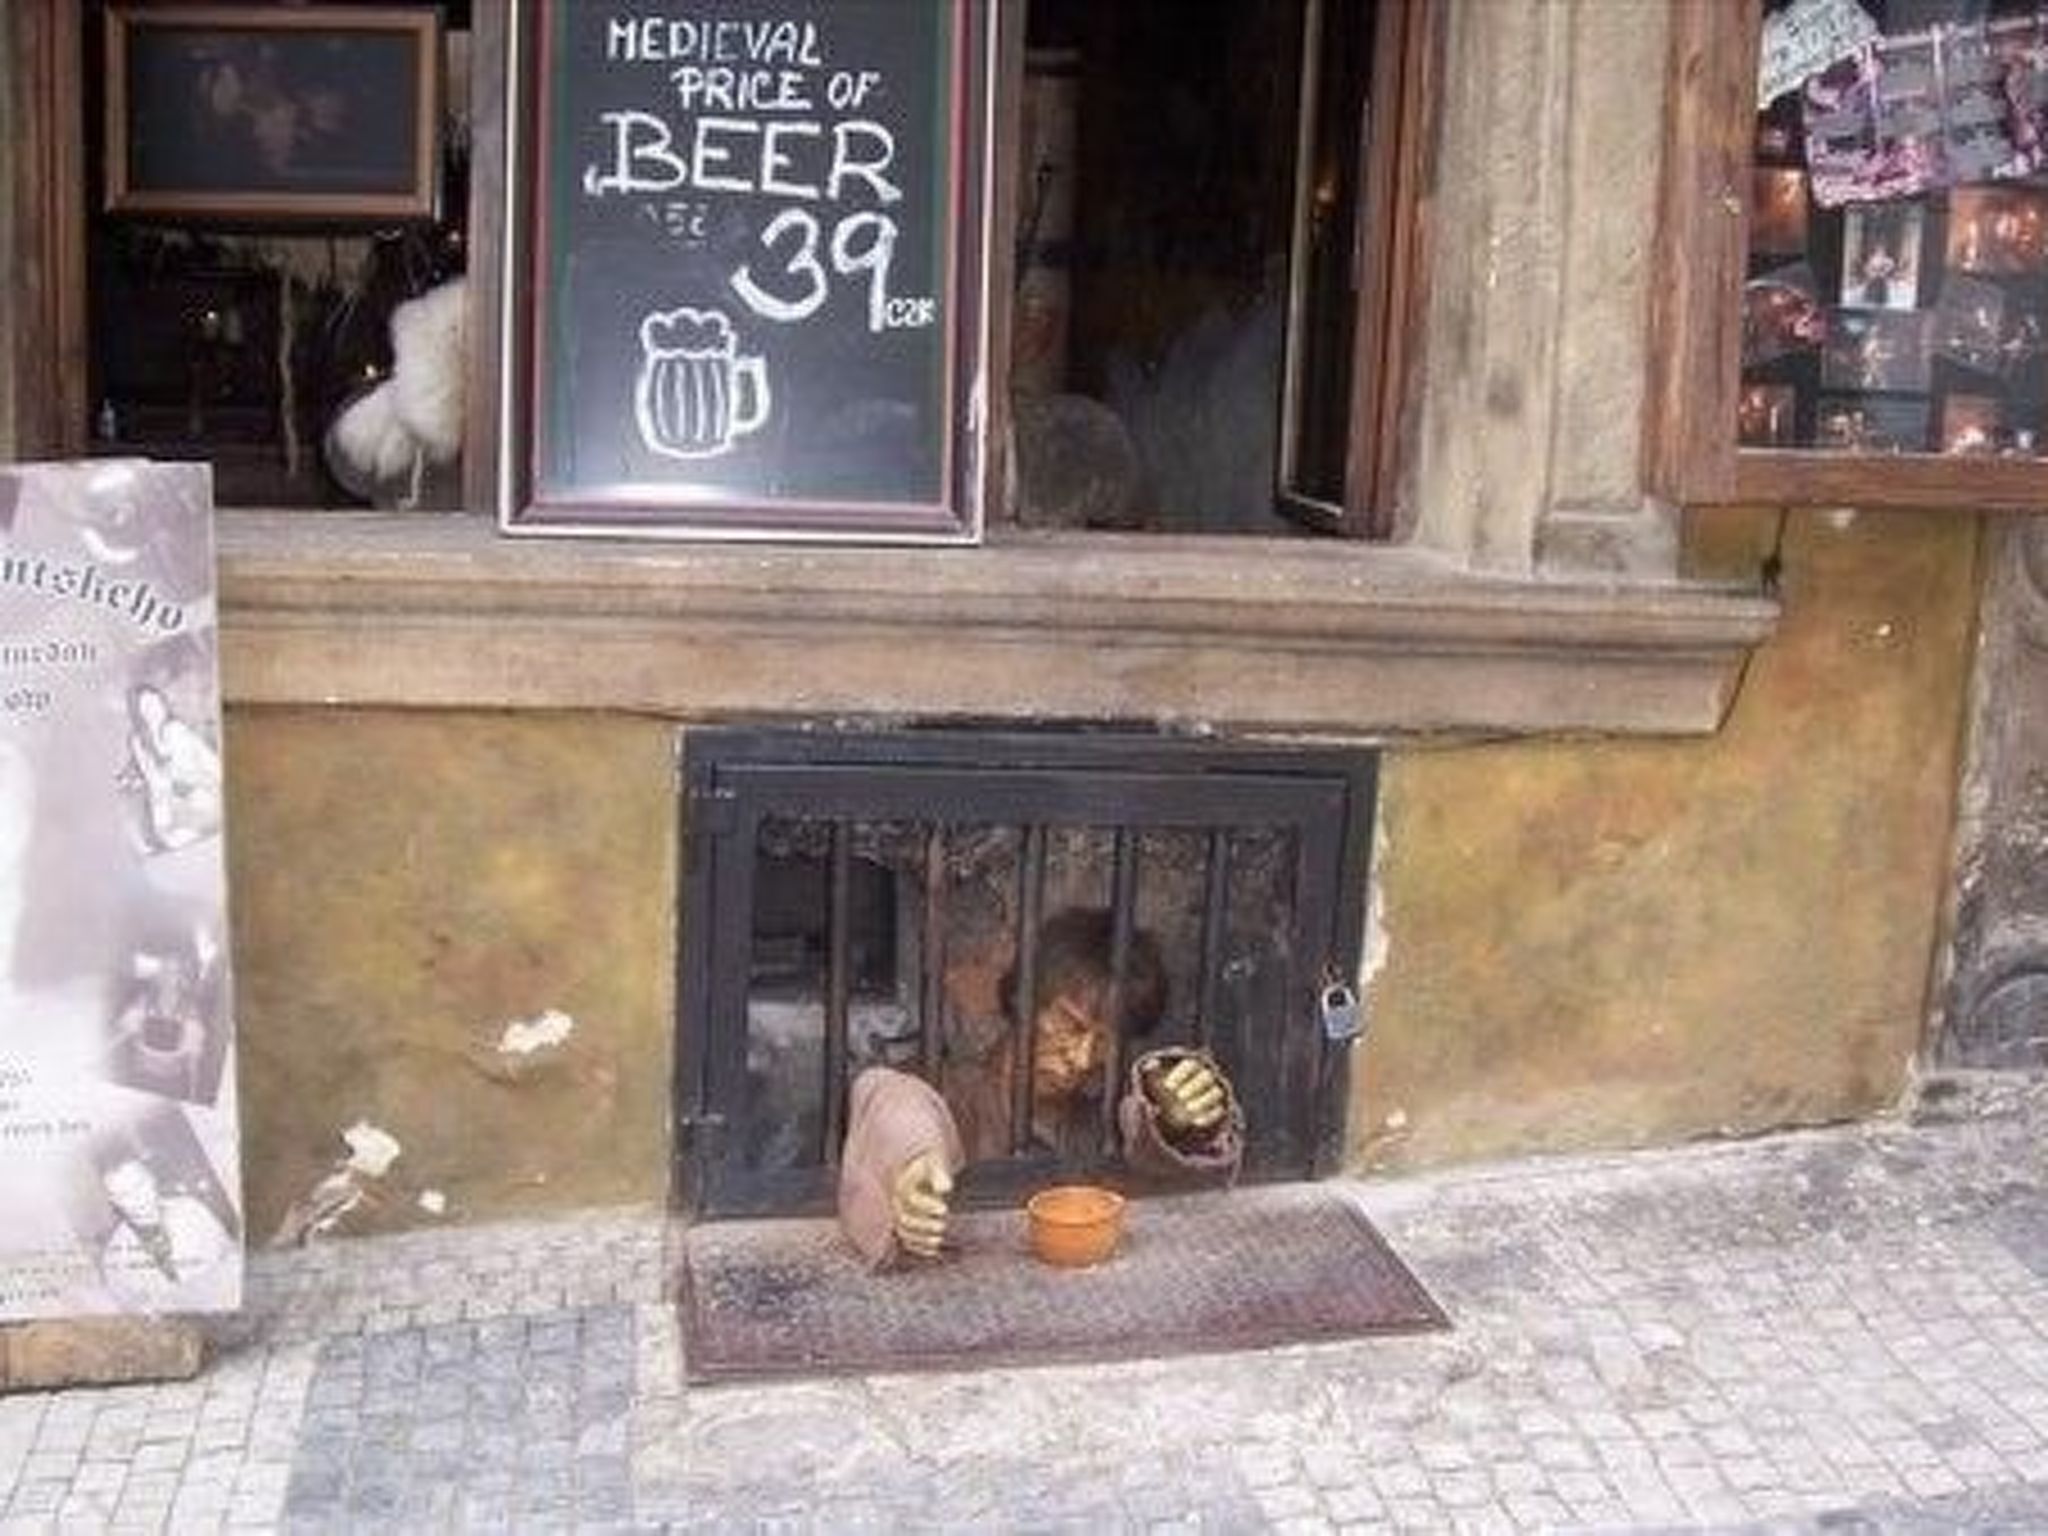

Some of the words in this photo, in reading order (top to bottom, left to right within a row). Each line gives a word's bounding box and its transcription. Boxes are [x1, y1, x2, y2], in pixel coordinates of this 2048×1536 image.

[607, 17, 821, 66] MEDIEVAL
[669, 66, 812, 110] PRICE
[827, 71, 881, 108] OF
[584, 110, 902, 200] BEER
[730, 208, 899, 333] 39
